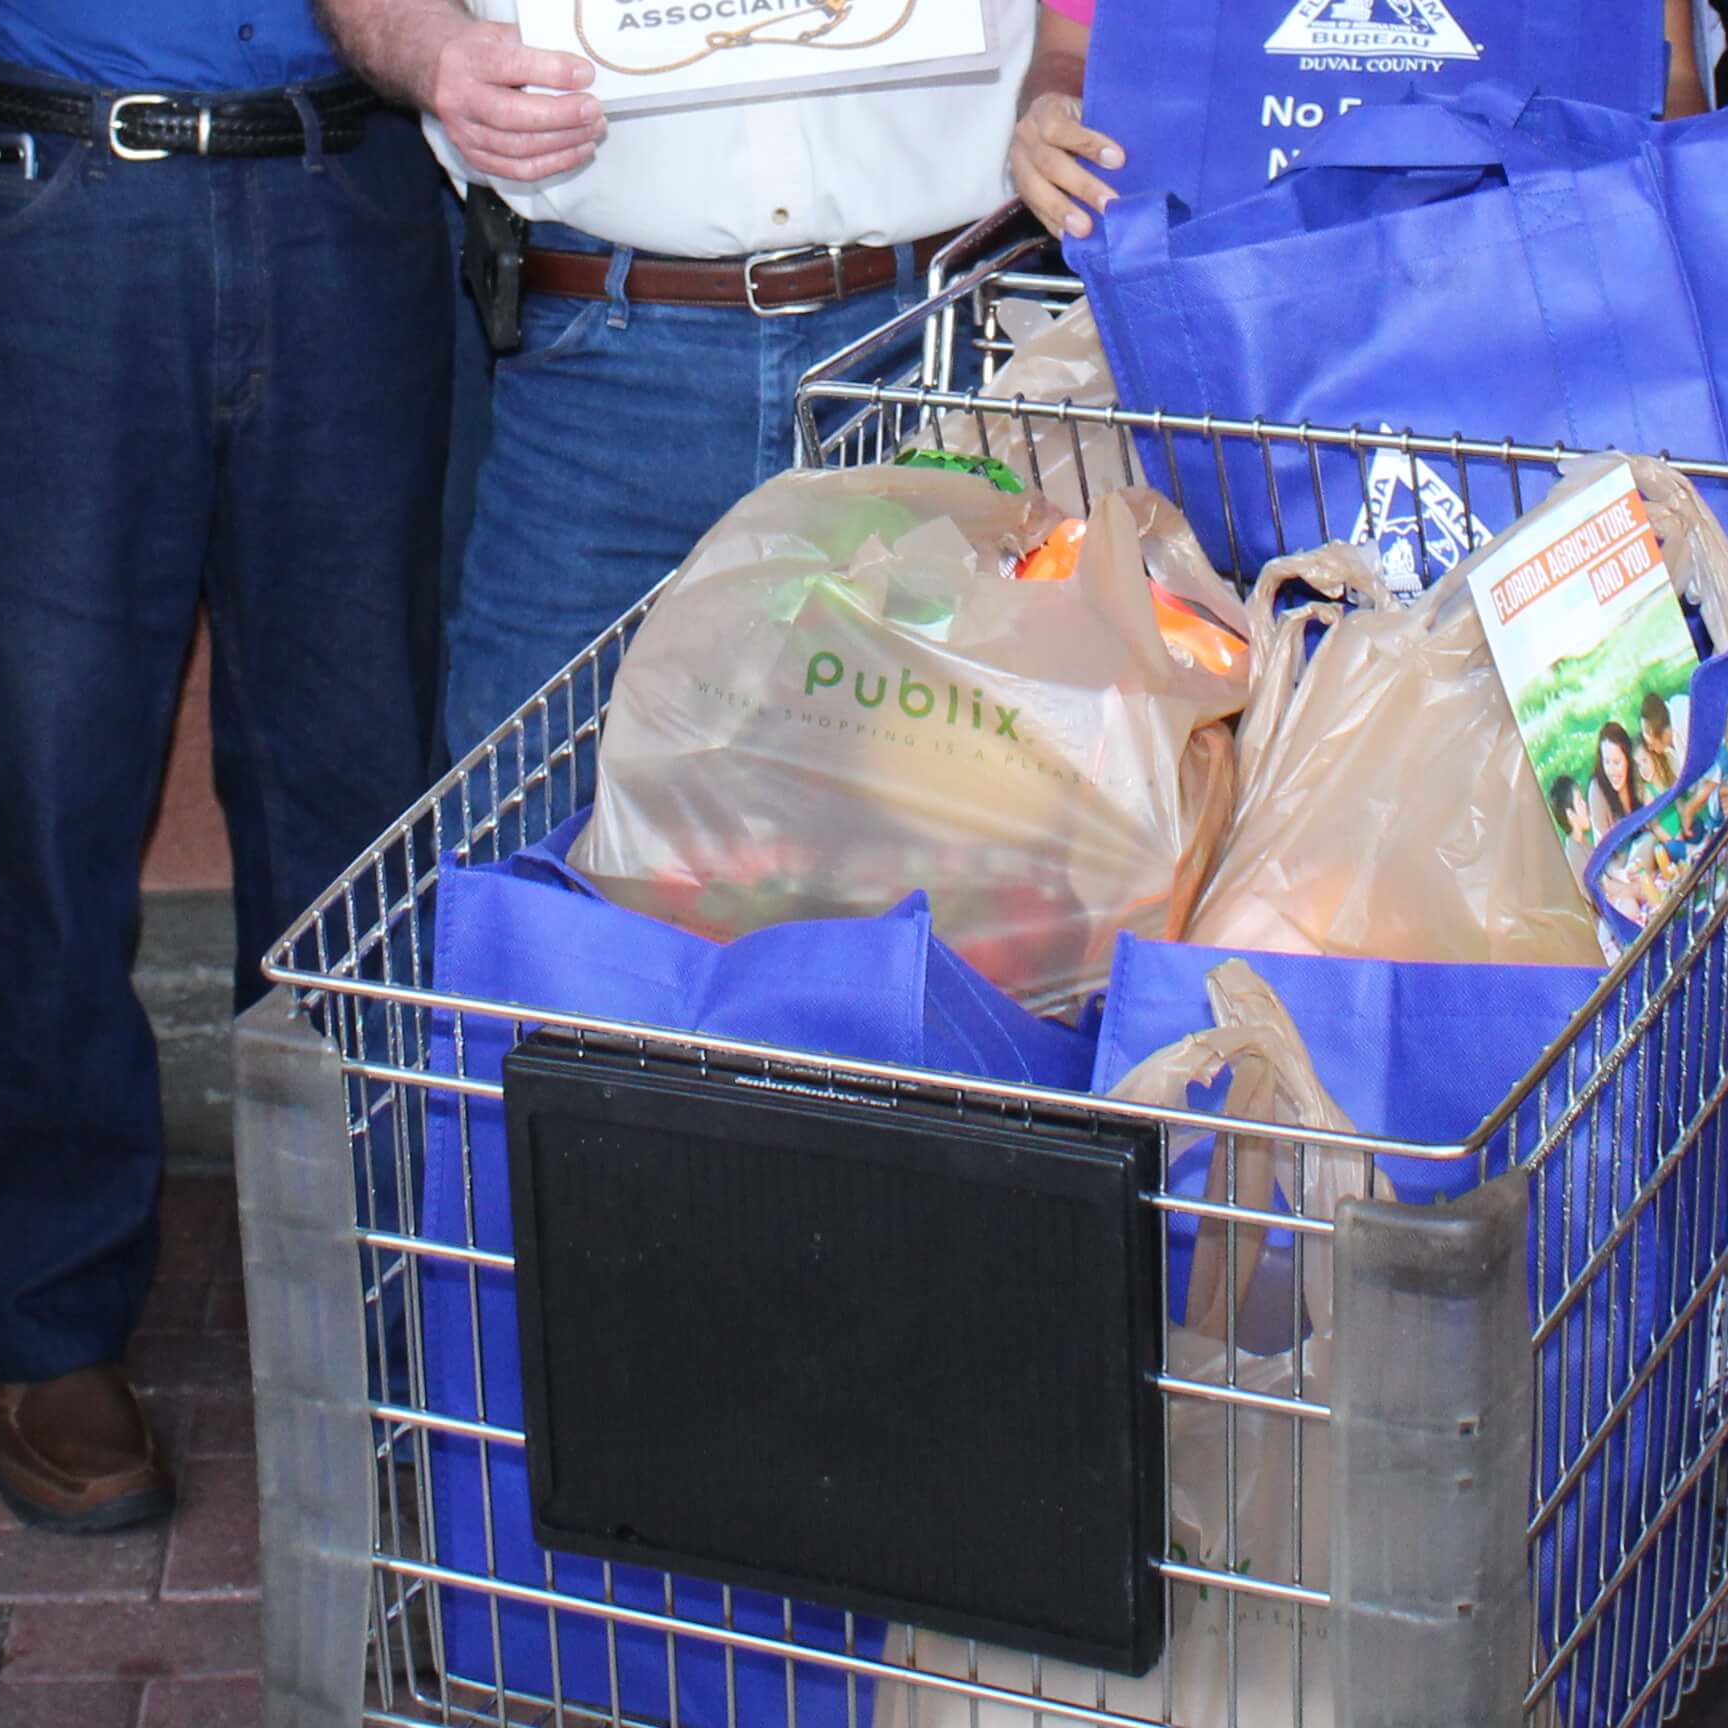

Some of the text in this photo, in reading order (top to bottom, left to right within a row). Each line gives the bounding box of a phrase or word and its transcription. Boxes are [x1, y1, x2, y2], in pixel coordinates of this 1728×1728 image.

[1312, 31, 1430, 49] BUREAU
[1300, 57, 1444, 73] DUVAL COUNTY
[1261, 94, 1324, 129] No
[1492, 498, 1638, 619] FLORIDA AGRICULTURE
[1591, 538, 1652, 601] AND YOU
[783, 708, 916, 746] SHOPPING
